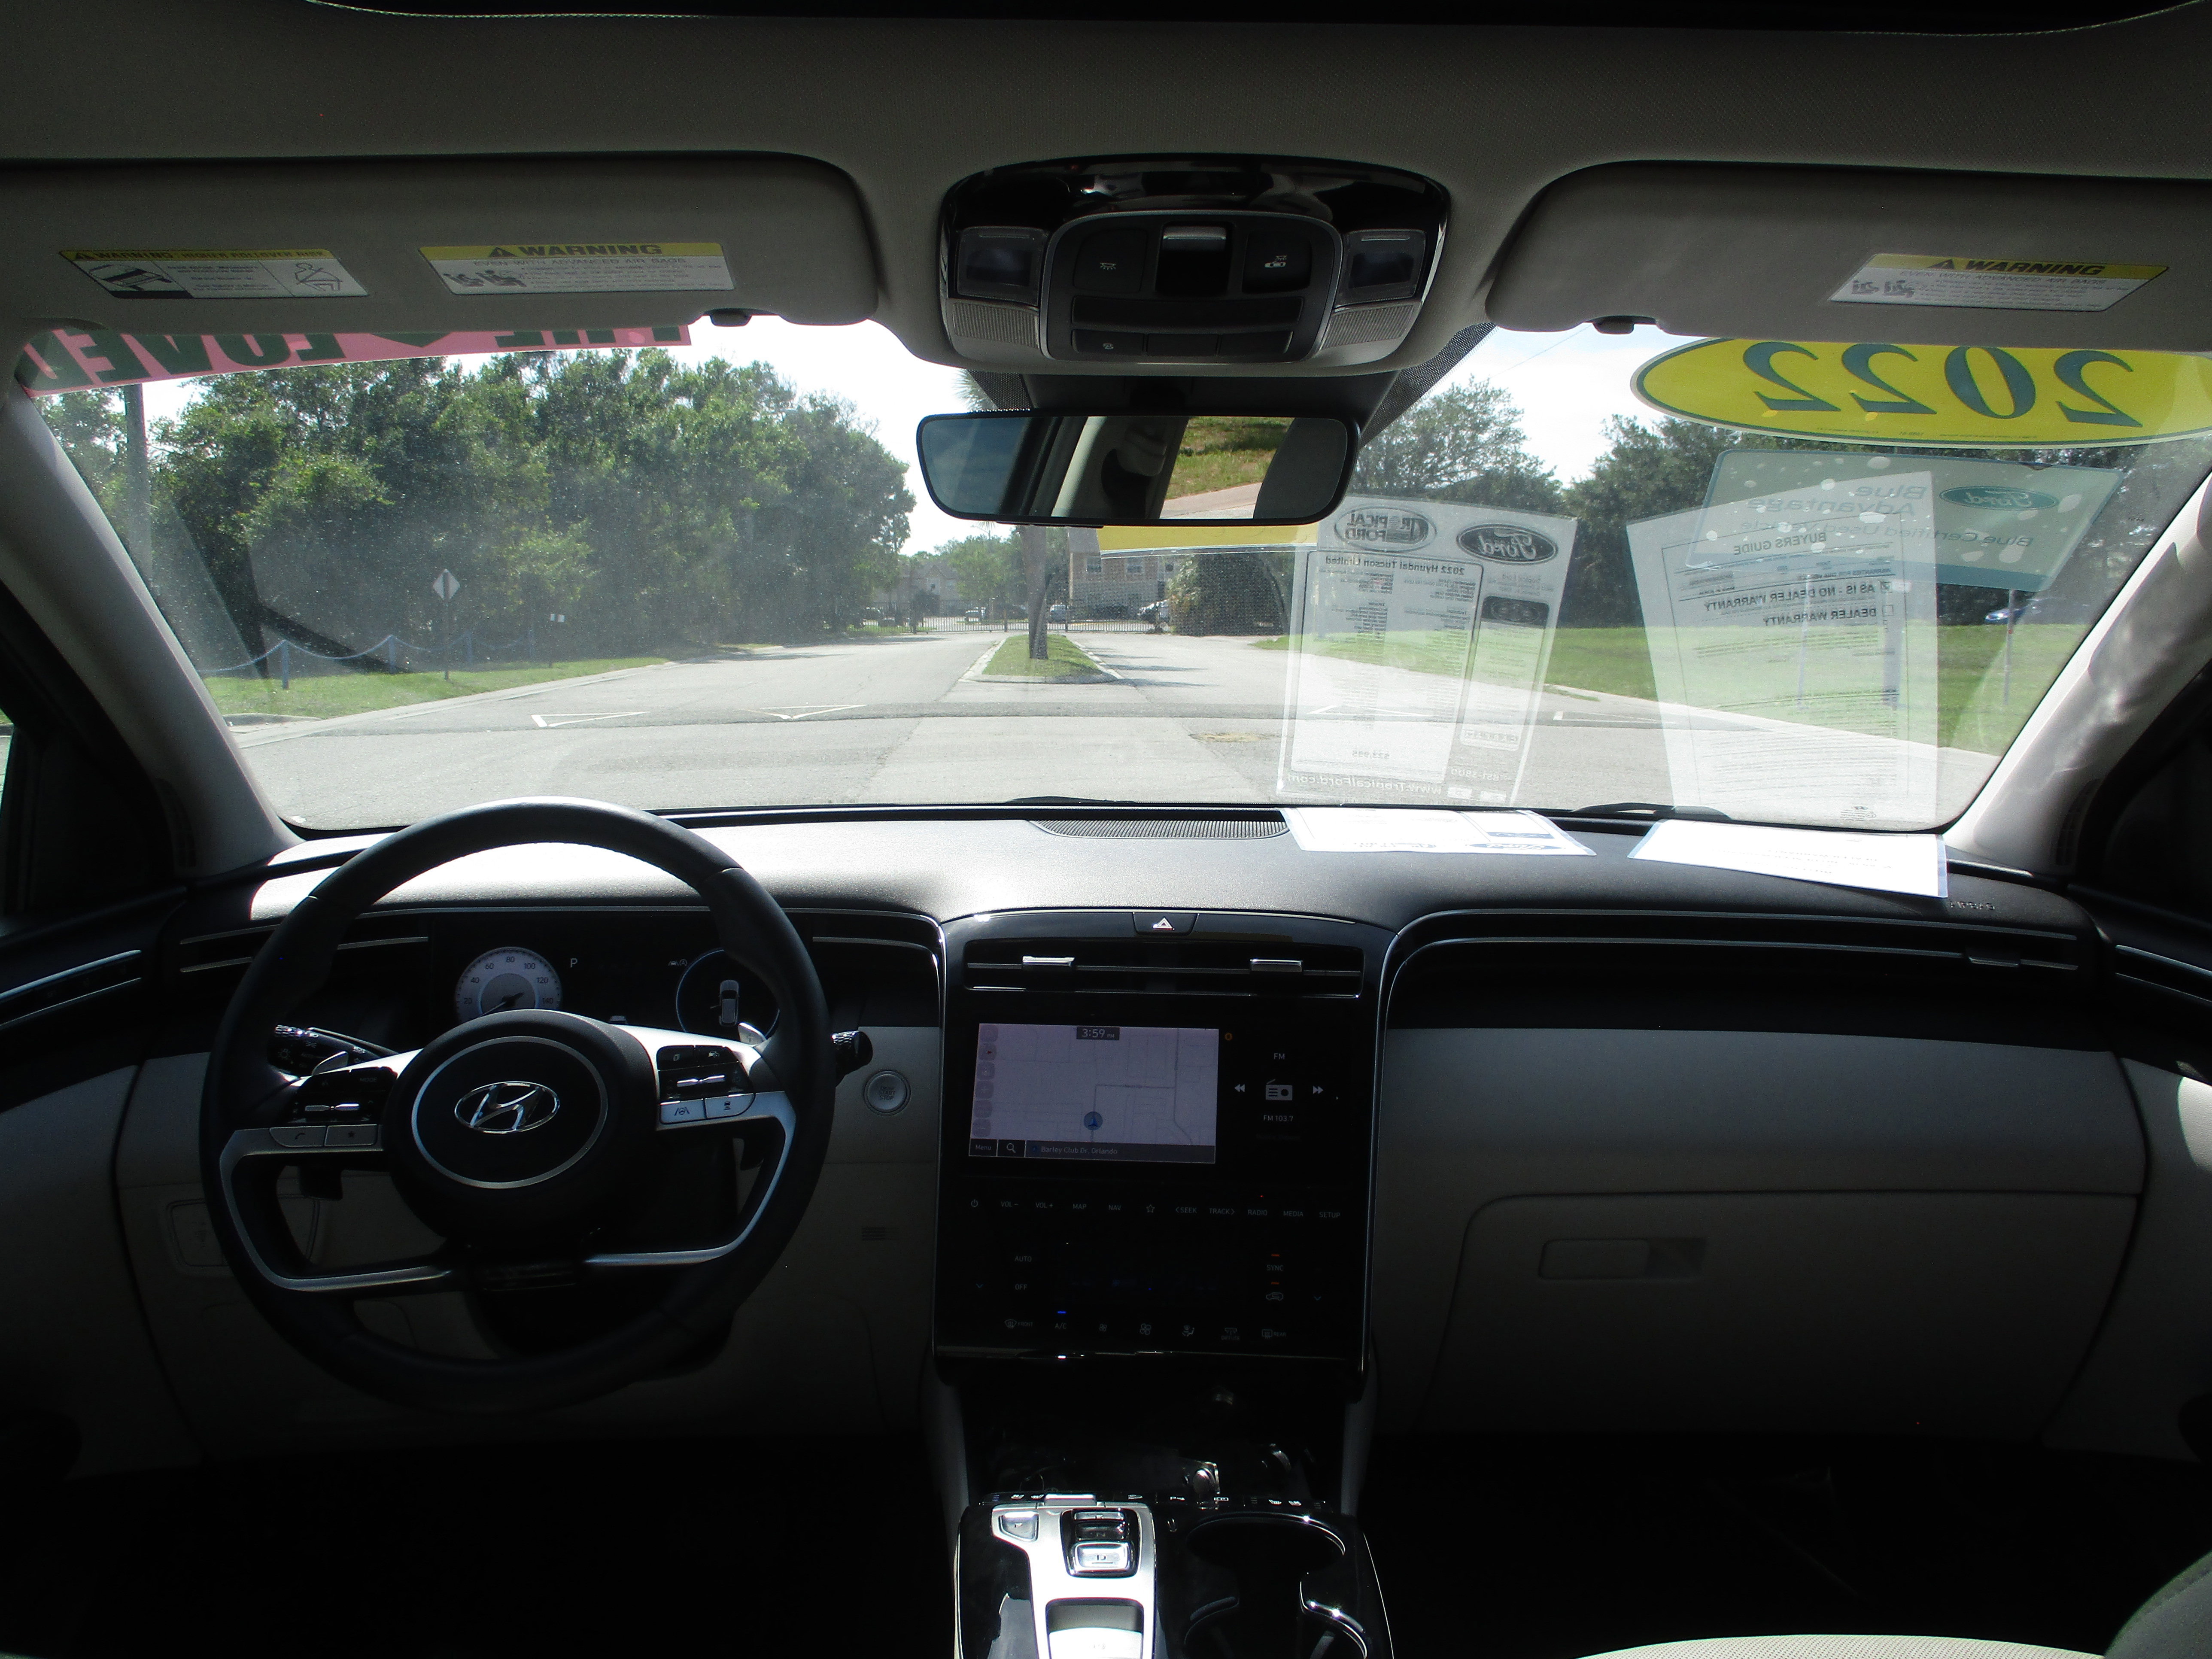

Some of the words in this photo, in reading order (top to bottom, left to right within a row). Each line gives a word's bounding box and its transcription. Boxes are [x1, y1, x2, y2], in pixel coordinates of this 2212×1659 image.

[518, 245, 662, 256] WARNING
[1965, 260, 2106, 275] WARNING
[570, 958, 577, 968] P
[1082, 1028, 1105, 1037] 3:59
